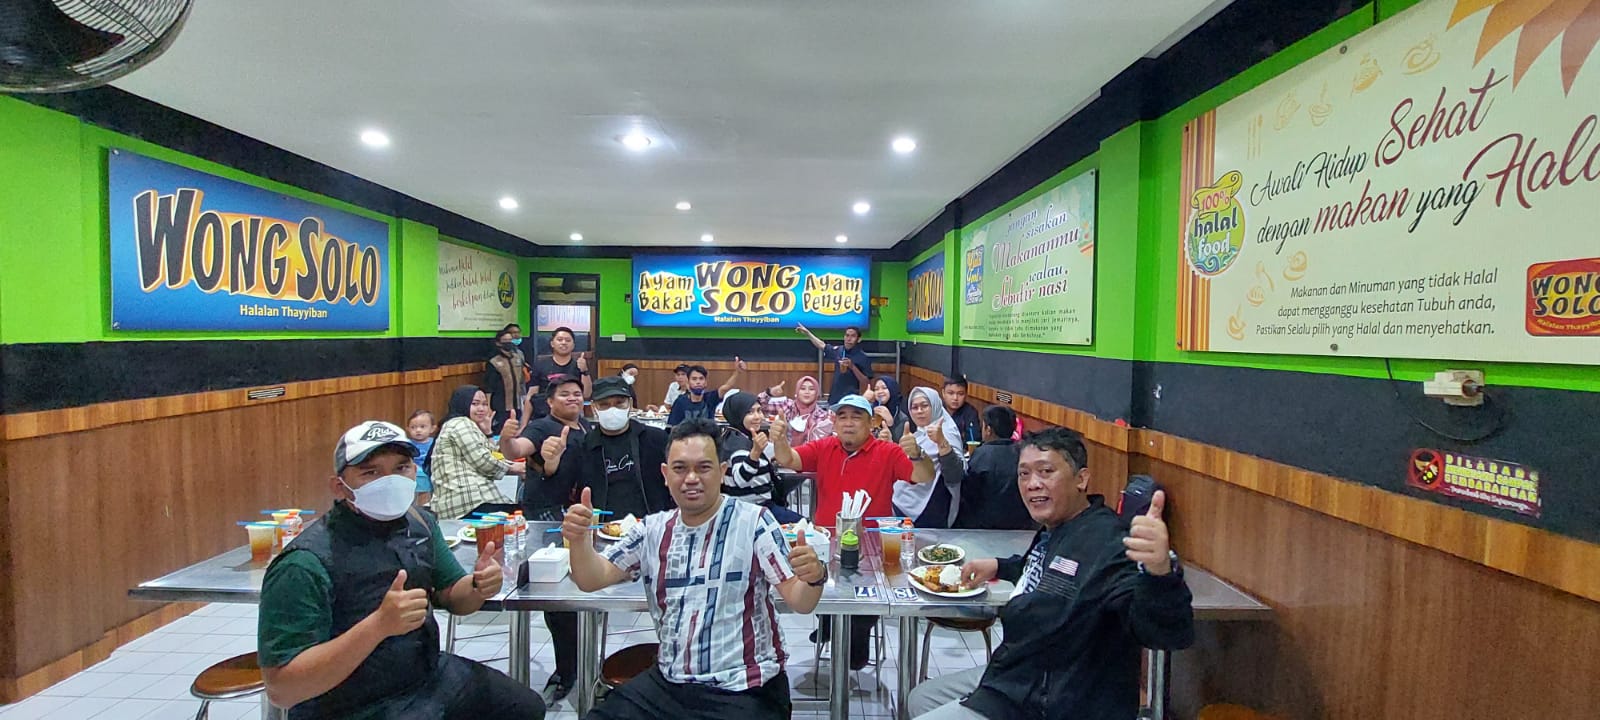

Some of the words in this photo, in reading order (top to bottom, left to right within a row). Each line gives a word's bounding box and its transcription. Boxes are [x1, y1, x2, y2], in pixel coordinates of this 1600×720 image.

[1250, 161, 1306, 206] Awali
[1305, 145, 1369, 189] Hidup
[1375, 68, 1509, 168] Sehat
[1202, 191, 1230, 211] 100%
[1194, 207, 1238, 237] halal
[1257, 216, 1312, 255] dengan
[1313, 180, 1414, 234] makan
[1408, 180, 1484, 233] yang
[134, 188, 290, 296] WONG
[296, 216, 381, 306] SOLO
[992, 228, 1079, 272] Makananmu
[1198, 231, 1231, 261] food
[639, 271, 693, 291] Ayam
[695, 260, 801, 291] WONG
[805, 273, 861, 292] Ayam
[1291, 286, 1328, 298] Makanan
[1330, 283, 1346, 295] dan
[1348, 281, 1395, 294] Minuman
[1398, 277, 1426, 293] yang
[1429, 272, 1460, 288] tidak
[1463, 267, 1498, 286] Halal
[1531, 272, 1600, 297] WON
[638, 291, 695, 311] Bakar
[1039, 280, 1067, 298] nasi
[240, 304, 279, 317] Halalan
[281, 306, 328, 320] Thayyiban
[699, 288, 796, 316] SOLO
[803, 292, 862, 312] Penyet
[1278, 305, 1300, 319] dapat
[1302, 305, 1358, 318] mengganggu
[1361, 300, 1414, 314] kesehatan
[1417, 296, 1455, 311] Tubuh
[1458, 294, 1496, 311] anda,
[743, 316, 780, 324] Thayyiban
[1256, 324, 1286, 335] Pastikan
[1287, 323, 1310, 335] Selalu
[1312, 323, 1330, 338] pilih
[1332, 324, 1354, 338] yang
[1356, 322, 1380, 335] Halal
[1383, 321, 1402, 334] dan
[1405, 319, 1495, 338] menyehatkan.
[1445, 454, 1539, 482] DILARANG
[857, 587, 877, 597] 17
[894, 588, 916, 598] 18
